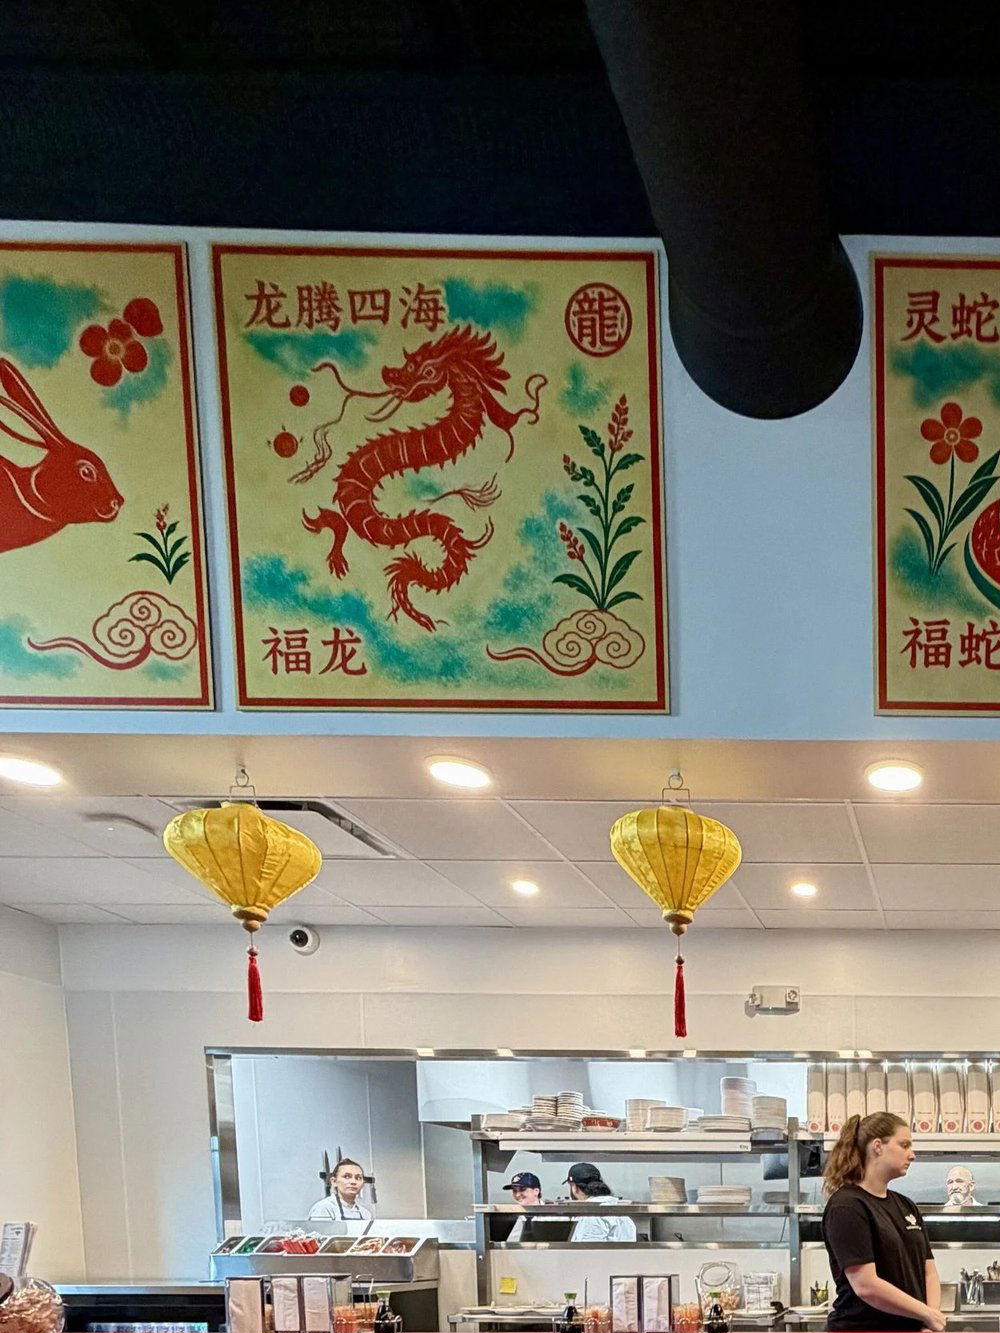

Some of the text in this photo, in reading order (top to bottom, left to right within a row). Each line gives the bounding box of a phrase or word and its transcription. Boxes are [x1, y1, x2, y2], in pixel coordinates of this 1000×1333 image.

[243, 278, 447, 333] 龙腾四海
[570, 287, 626, 350] 龍
[260, 626, 368, 676] 福龙
